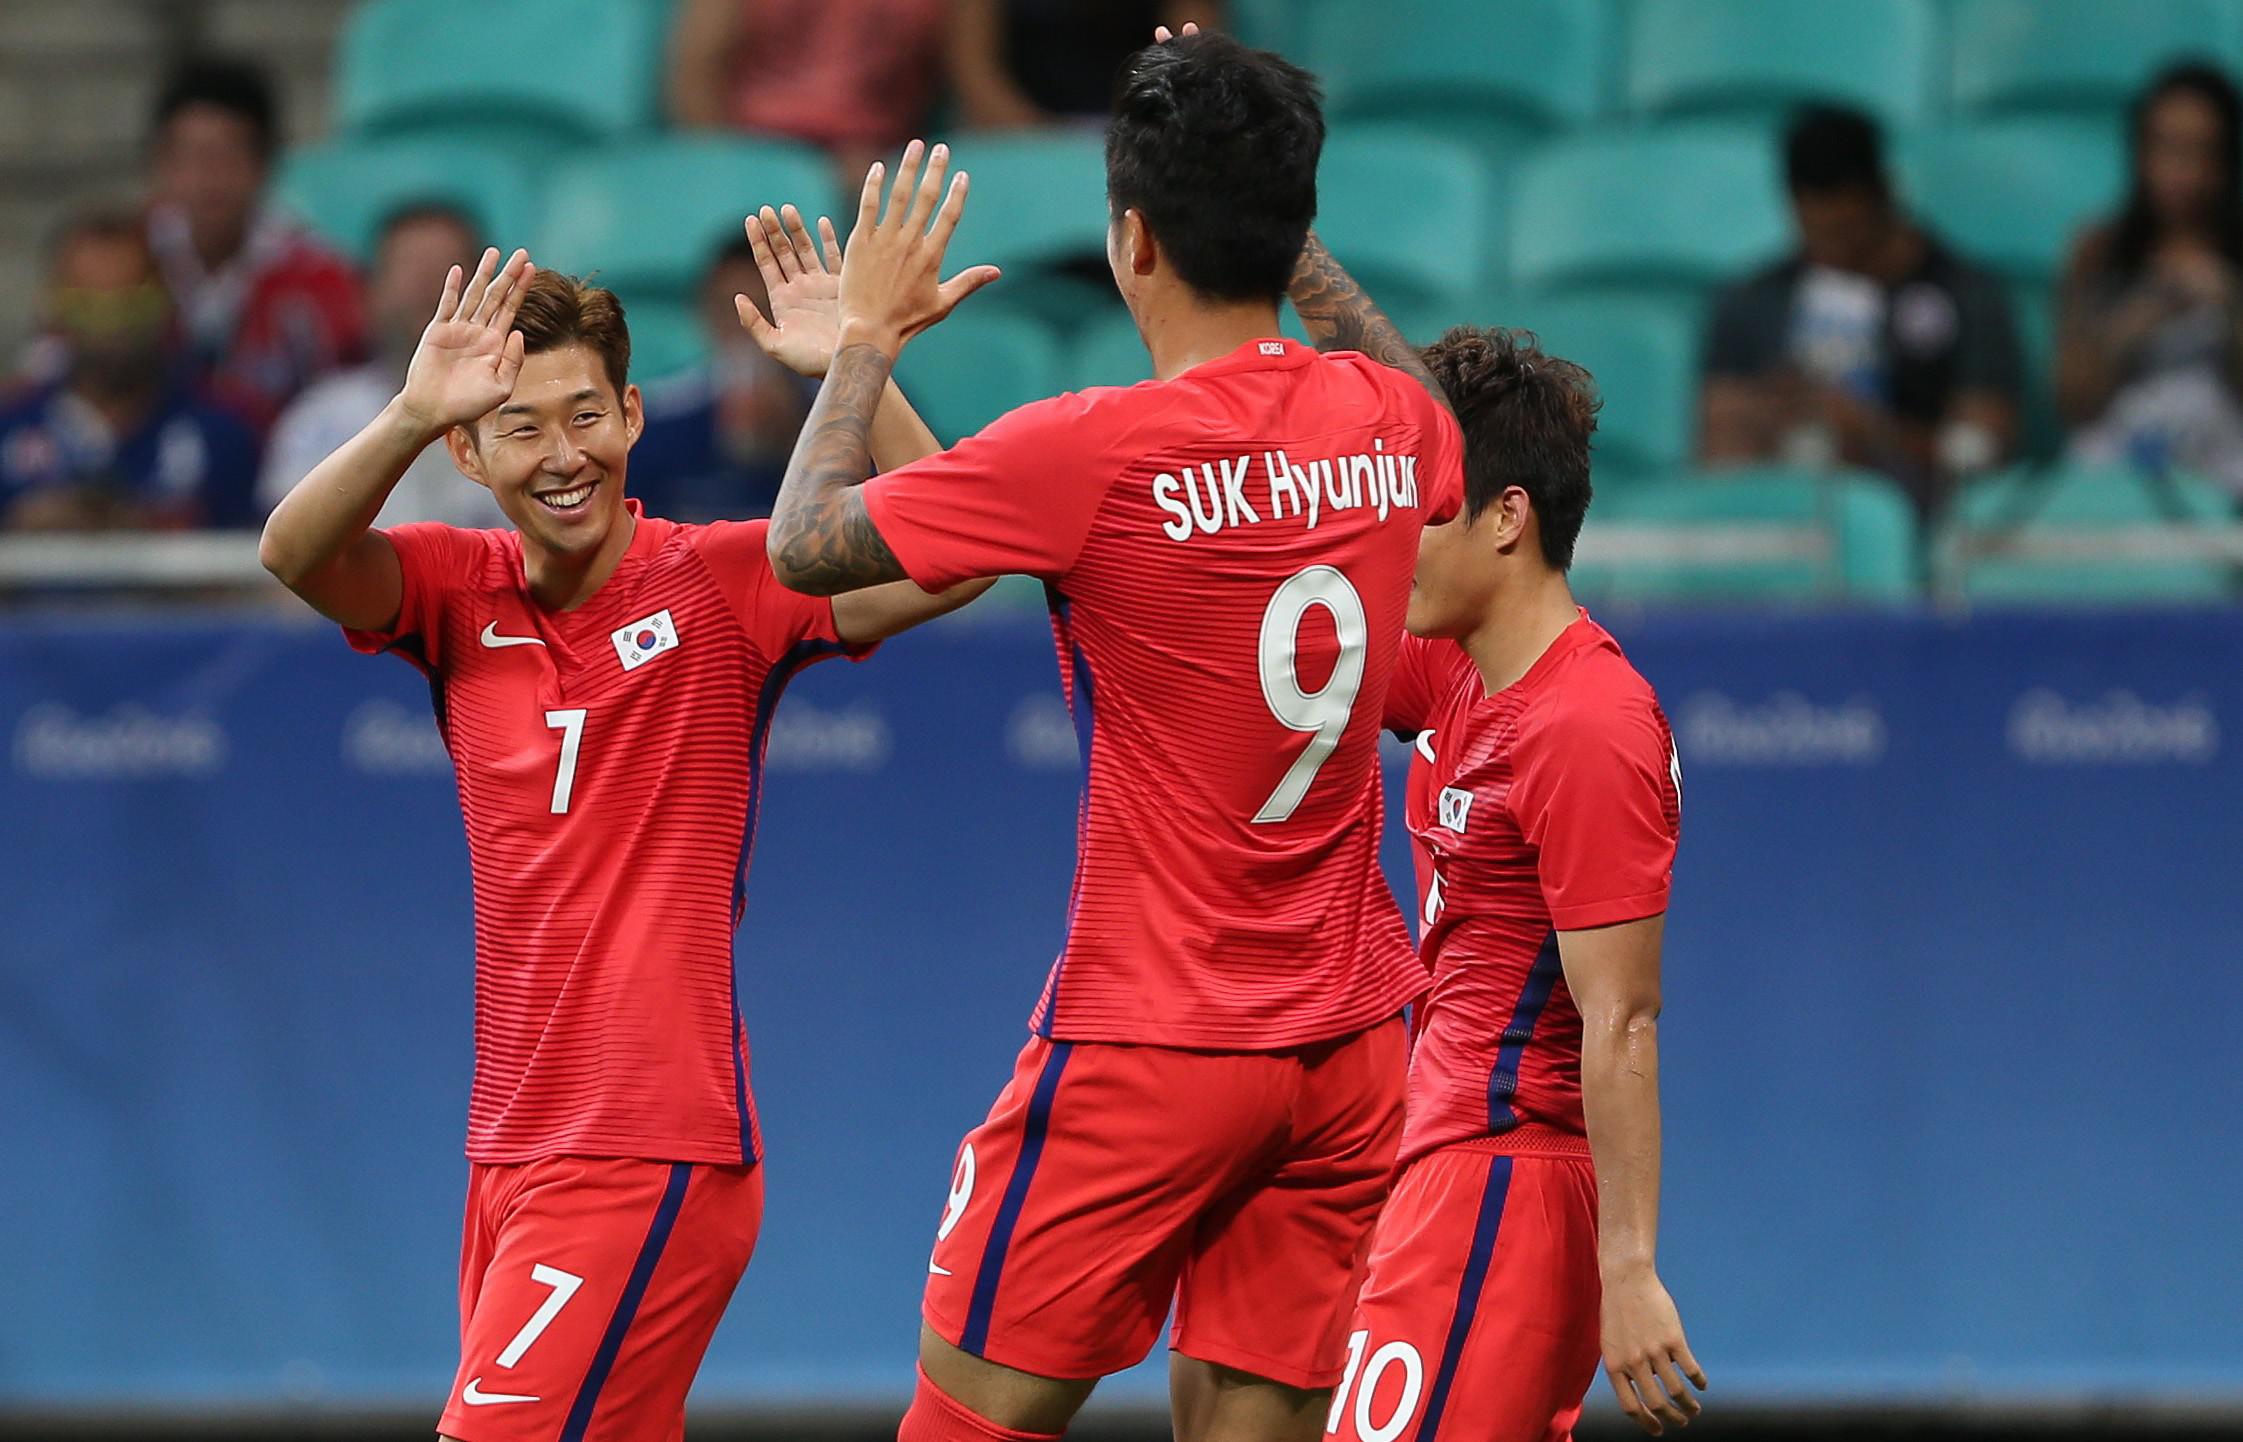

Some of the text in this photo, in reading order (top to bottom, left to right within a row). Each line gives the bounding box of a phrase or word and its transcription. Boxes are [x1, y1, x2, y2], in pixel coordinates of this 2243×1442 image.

[1152, 455, 1261, 542] SUK
[1251, 564, 1367, 823] 9
[545, 709, 587, 815] 7
[937, 1142, 976, 1242] 9
[496, 1263, 584, 1369] 7
[1326, 1330, 1424, 1442] 10
